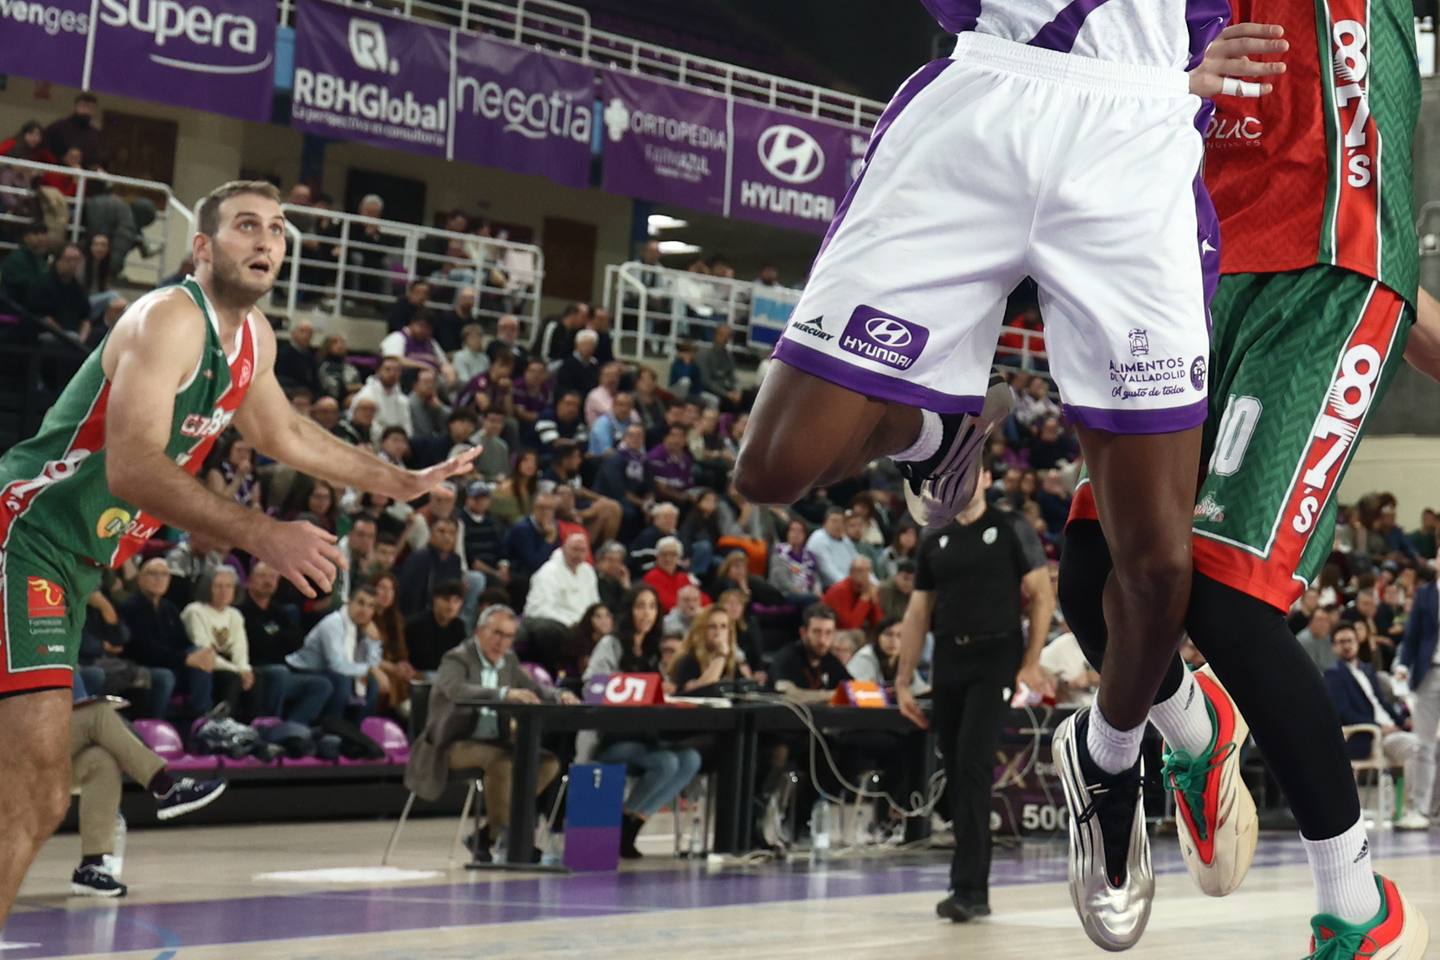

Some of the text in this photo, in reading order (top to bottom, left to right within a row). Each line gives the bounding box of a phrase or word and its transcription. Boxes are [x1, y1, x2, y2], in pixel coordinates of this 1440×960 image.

[292, 66, 448, 133] RBHGlobal
[456, 74, 593, 144] negotia
[631, 110, 727, 152] ORTOPEDIA
[740, 179, 836, 222] HYUNDAI
[792, 320, 835, 342] MERCURY
[843, 335, 914, 369] HYUNDAI
[1109, 356, 1185, 373] ALIMENTOS
[1119, 370, 1186, 384] VALLADOLID
